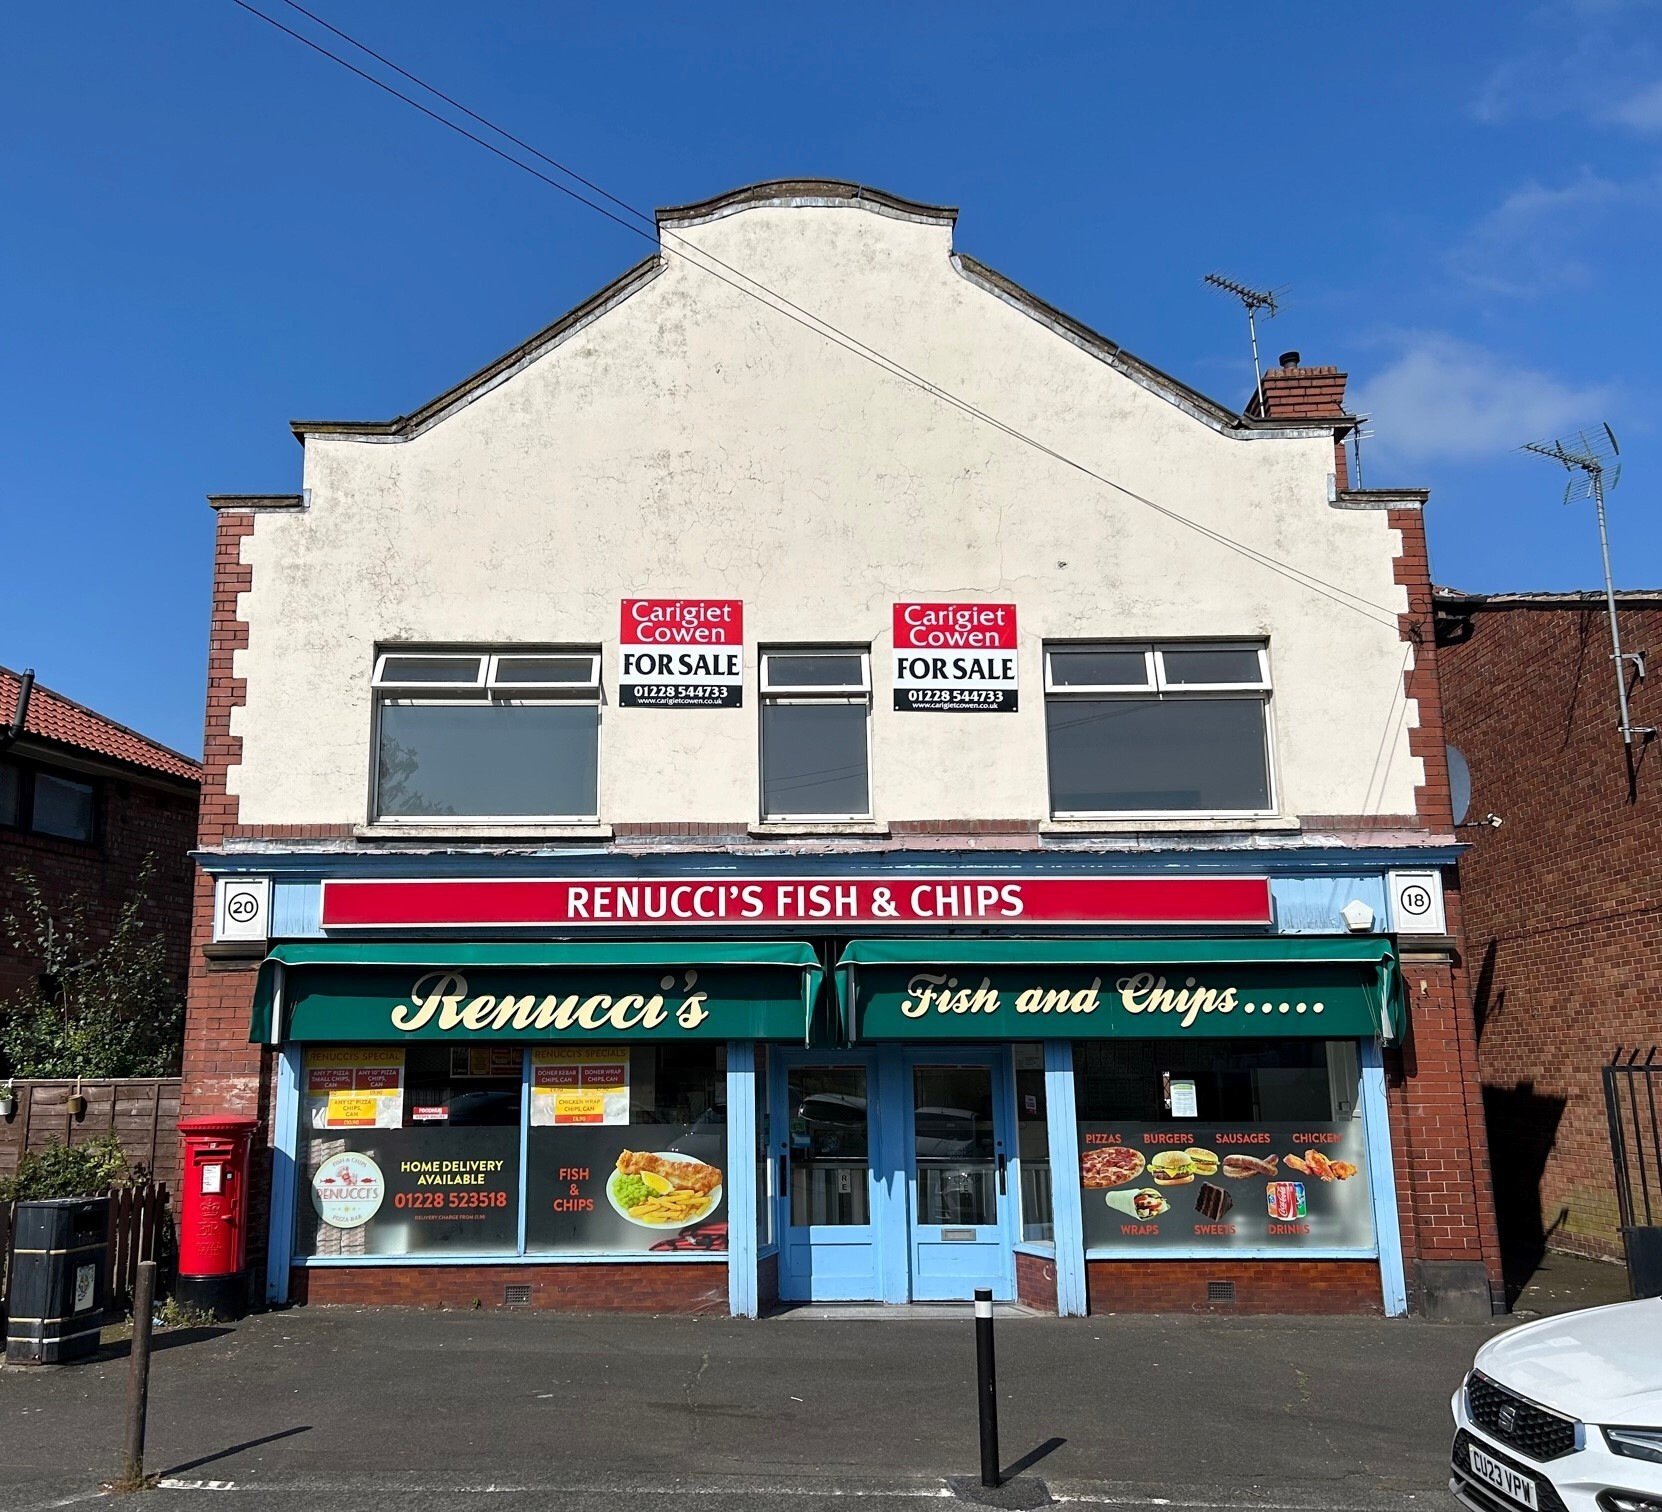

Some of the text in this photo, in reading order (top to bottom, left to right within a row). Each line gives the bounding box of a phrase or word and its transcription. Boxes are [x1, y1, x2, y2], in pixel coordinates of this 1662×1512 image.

[632, 601, 732, 627] Carigiet
[904, 605, 1005, 631] Carigiet
[636, 622, 726, 642] Cowen
[909, 626, 1000, 646] Cowen
[623, 653, 740, 676] FOR SALE
[897, 657, 1015, 680] FOR SALE
[634, 686, 728, 698] 01228 544733
[908, 690, 1004, 702] 01228 544733
[567, 883, 1024, 918] RENUCCI'S FISH & CHIPS
[1404, 892, 1425, 909] 18
[233, 899, 255, 916] 20
[391, 969, 711, 1031] Renucci's
[901, 973, 1001, 1019] Fish
[1014, 977, 1101, 1014] and
[585, 1048, 626, 1057] SPECIALS
[1085, 1133, 1122, 1144] PIZZAS
[1143, 1133, 1194, 1144] BURGERS
[1215, 1133, 1271, 1144] SAUSAGES
[1292, 1133, 1342, 1144] CHICKEN
[401, 1160, 504, 1172] HOME DELIVERY
[417, 1173, 485, 1185] AVAILABLE
[559, 1168, 590, 1180] FISH
[316, 1187, 378, 1199] RENUCCI'S
[569, 1184, 579, 1195] &
[394, 1191, 507, 1208] 01228 523518
[553, 1199, 594, 1212] CHIPS
[1120, 1224, 1160, 1235] WRAPS
[1194, 1224, 1236, 1235] SWEETS
[1268, 1224, 1310, 1235] DRINKS
[1474, 1451, 1530, 1503] CU23 VPW
